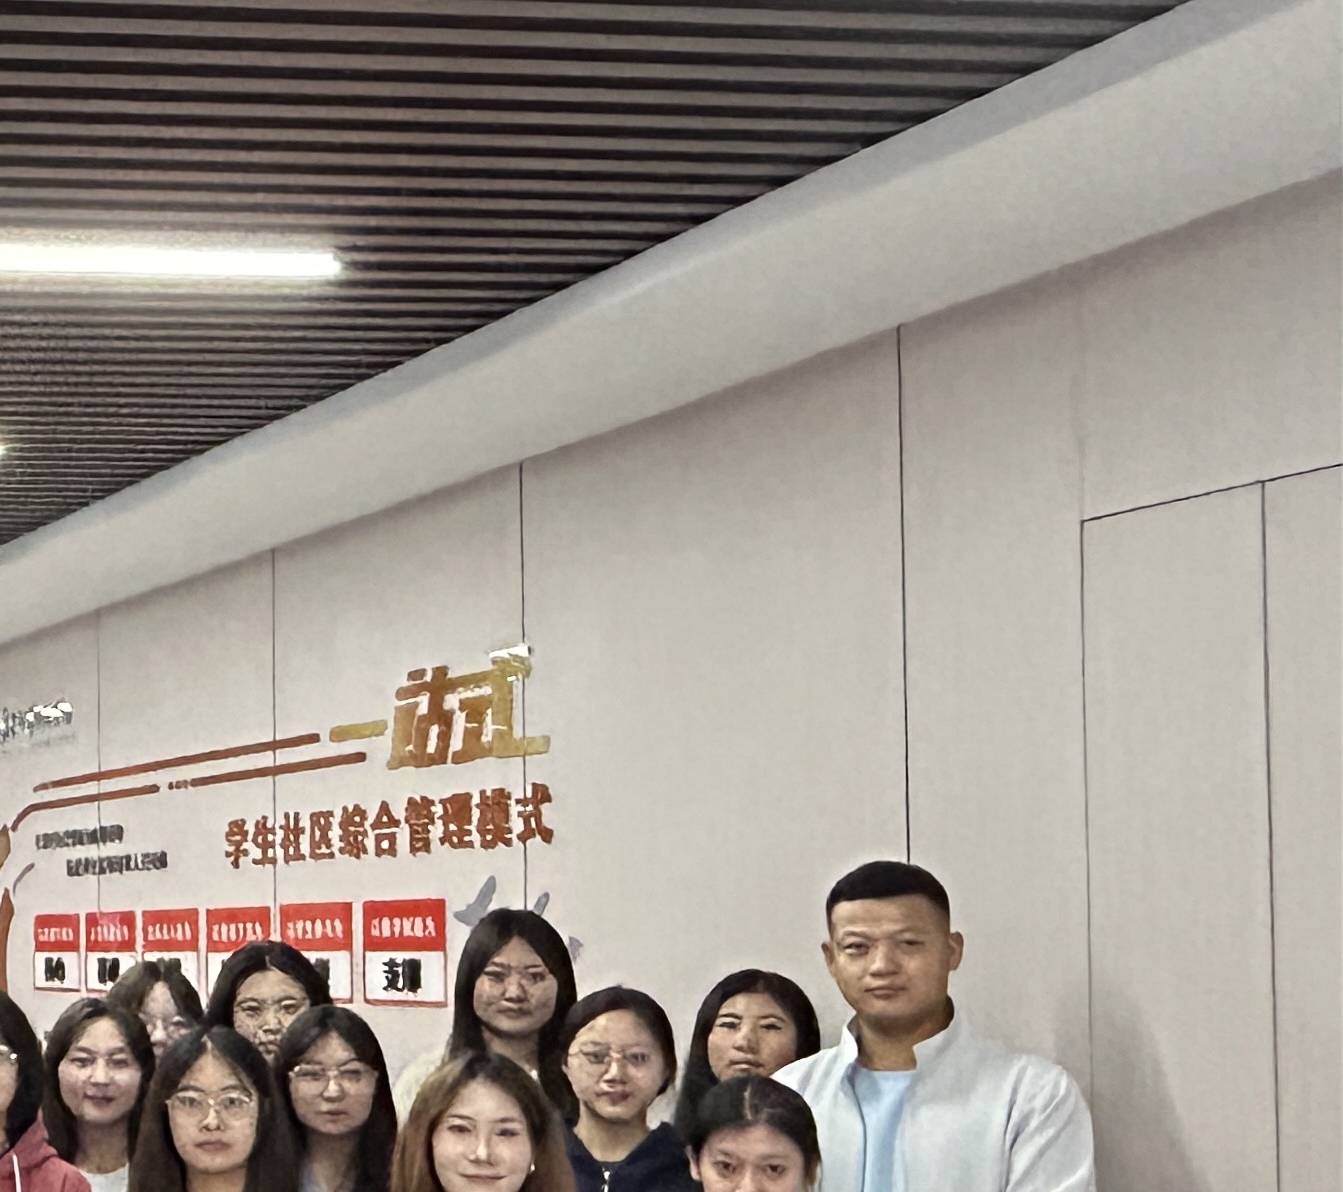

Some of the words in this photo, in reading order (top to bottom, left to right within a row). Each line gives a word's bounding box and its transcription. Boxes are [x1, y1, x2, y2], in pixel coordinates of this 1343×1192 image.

[224, 782, 554, 869] 学生社区综合管理模式
